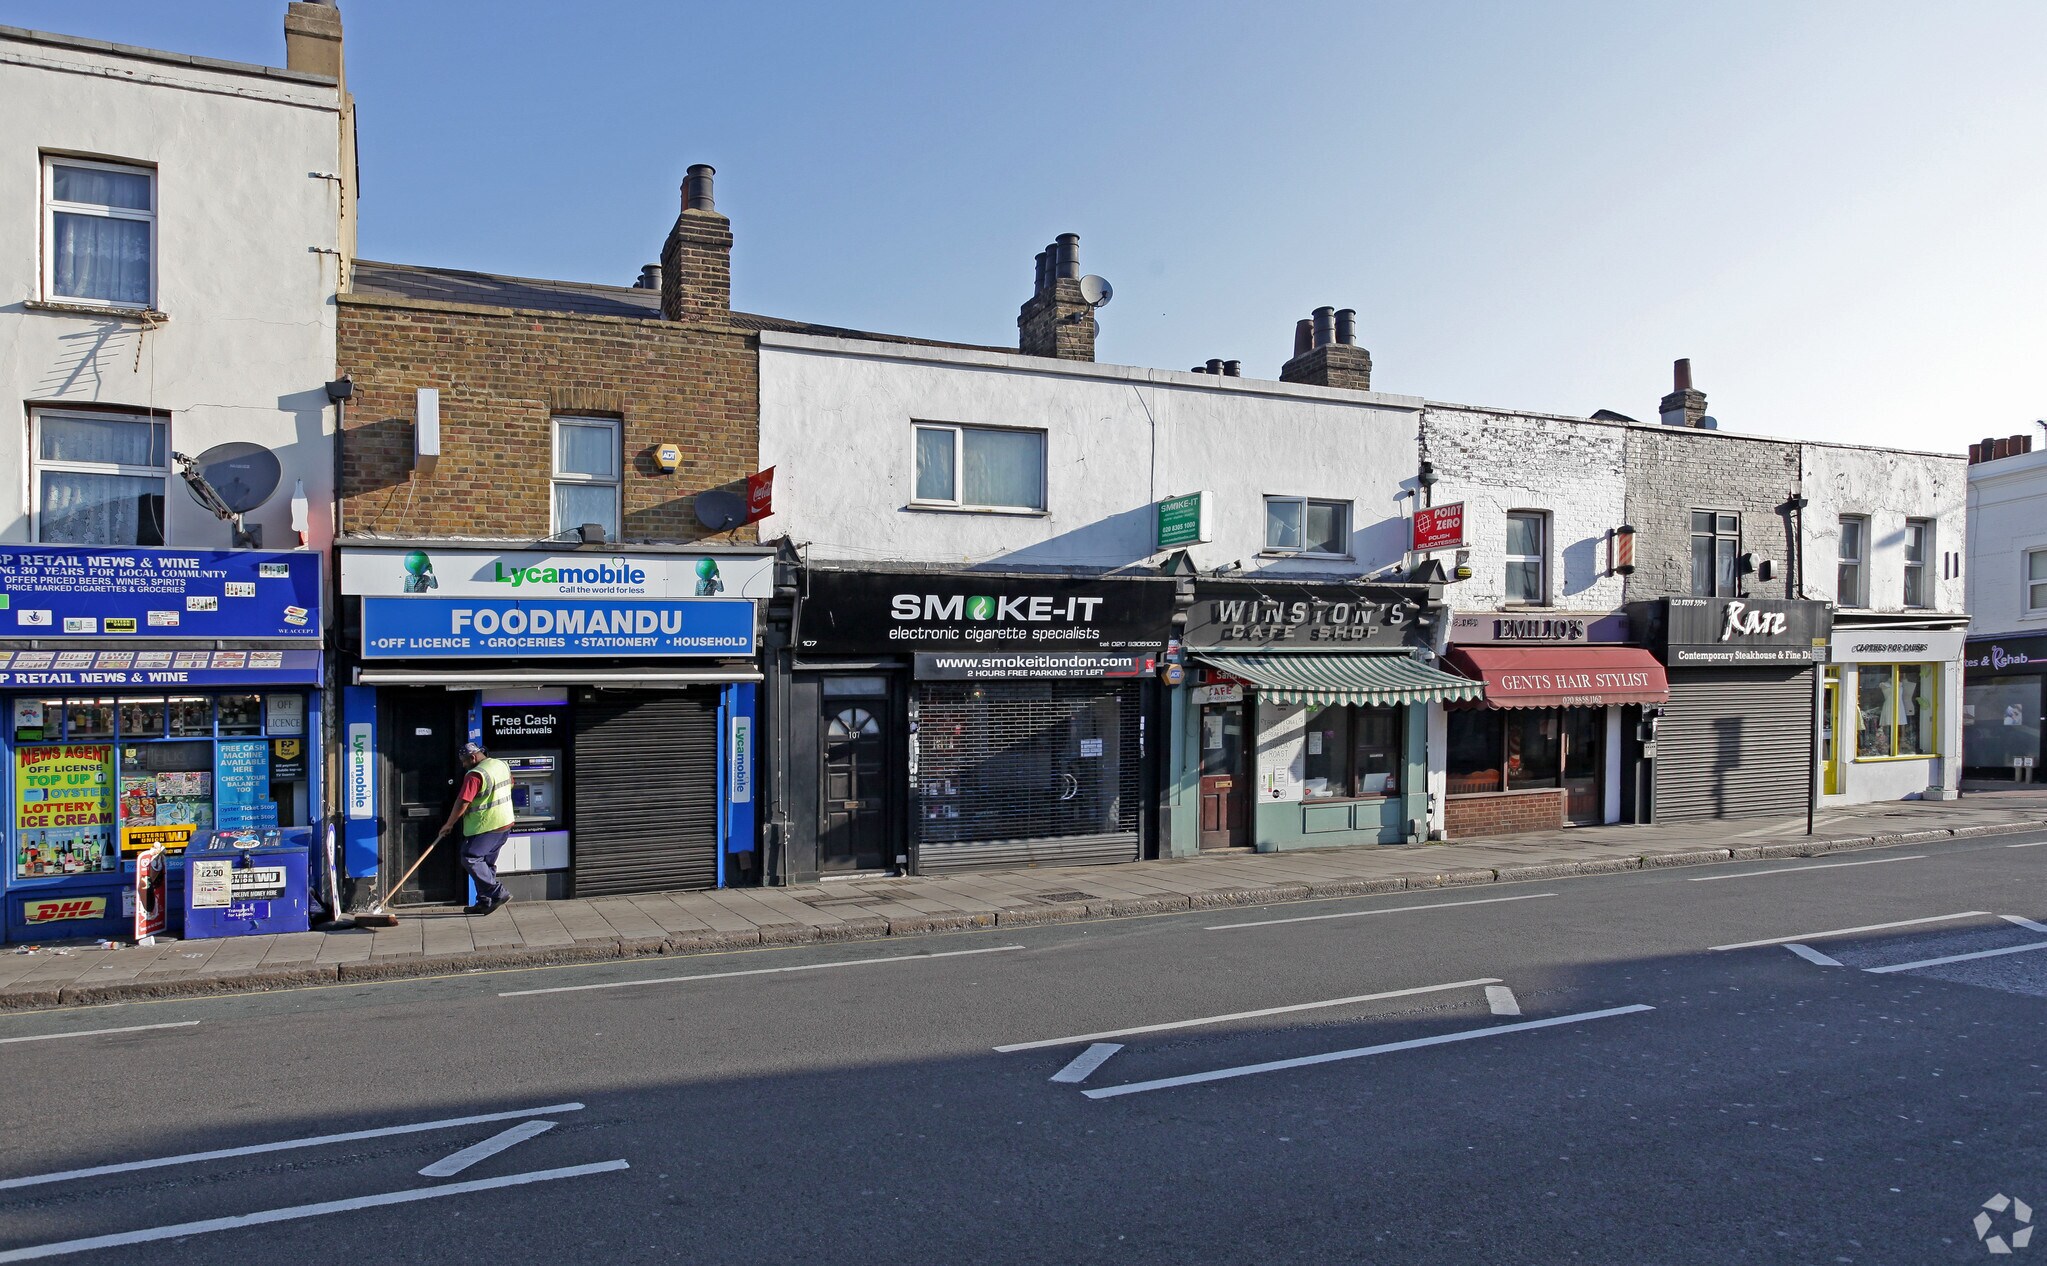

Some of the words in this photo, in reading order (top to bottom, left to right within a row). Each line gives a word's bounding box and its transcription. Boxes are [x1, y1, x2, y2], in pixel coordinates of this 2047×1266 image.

[1434, 505, 1462, 519] POINT
[1436, 518, 1460, 530] ZERO
[1418, 538, 1462, 548] DELICATESSEN
[19, 555, 82, 566] RETAIL
[86, 556, 135, 567] NEWS
[140, 557, 153, 568] &
[158, 558, 200, 568] WINE
[21, 566, 38, 574] 30
[44, 568, 84, 576] YEARS
[89, 568, 114, 576] FOR
[120, 569, 158, 577] LOCAL
[162, 570, 228, 578] COMMUNITY
[496, 562, 646, 587] Lycamobile
[4, 576, 38, 584] OFFER
[40, 576, 76, 584] PRICED
[79, 578, 114, 586] BEERS,
[890, 594, 1104, 622] SMOKE-IT
[451, 608, 682, 634] FOODMANDU
[1722, 600, 1788, 641] Rare
[889, 626, 960, 640] electronic
[964, 626, 1027, 642] cigarette
[1032, 626, 1100, 642] specialists
[1232, 625, 1296, 638] CAFE
[1319, 626, 1379, 638] SHOP
[1499, 618, 1584, 638] EMILIO'S
[378, 638, 406, 648] OFF
[410, 638, 470, 648] LICENCE
[488, 637, 566, 647] GROCERIES
[581, 637, 658, 646] STATIONERY
[673, 637, 748, 646] HOUSEHOLD
[1678, 650, 1734, 661] Contemporary
[1735, 650, 1776, 660] Steakhouse
[1785, 650, 1801, 659] Fine
[1981, 656, 1990, 666] &
[1992, 645, 2028, 670] Rehab
[936, 656, 1132, 668] www.smokeitlondon.com
[16, 674, 75, 683] RETAIL
[80, 673, 126, 683] NEWS
[131, 673, 143, 682] &
[148, 672, 188, 682] WINE
[1502, 675, 1551, 690] GENTS
[1556, 674, 1592, 689] HAIR
[1596, 672, 1648, 687] STYLIST
[277, 700, 293, 709] OFF
[268, 718, 300, 728] LICENCE
[492, 715, 521, 726] Free
[524, 714, 556, 725] Cash
[496, 726, 552, 735] withdrawals
[21, 746, 61, 768] NEWS
[64, 745, 111, 764] AGENT
[736, 727, 747, 793] Lycamobile
[55, 764, 103, 772] LICENSE
[353, 734, 367, 808] Lycamobile
[26, 775, 61, 786] TOP
[68, 774, 90, 785] UP
[51, 788, 110, 798] OYSTER
[24, 802, 94, 814] LOTTERY
[21, 816, 48, 827] ICE
[54, 812, 112, 826] CREAM
[202, 869, 223, 877] £2.90
[36, 901, 96, 920] DHL
